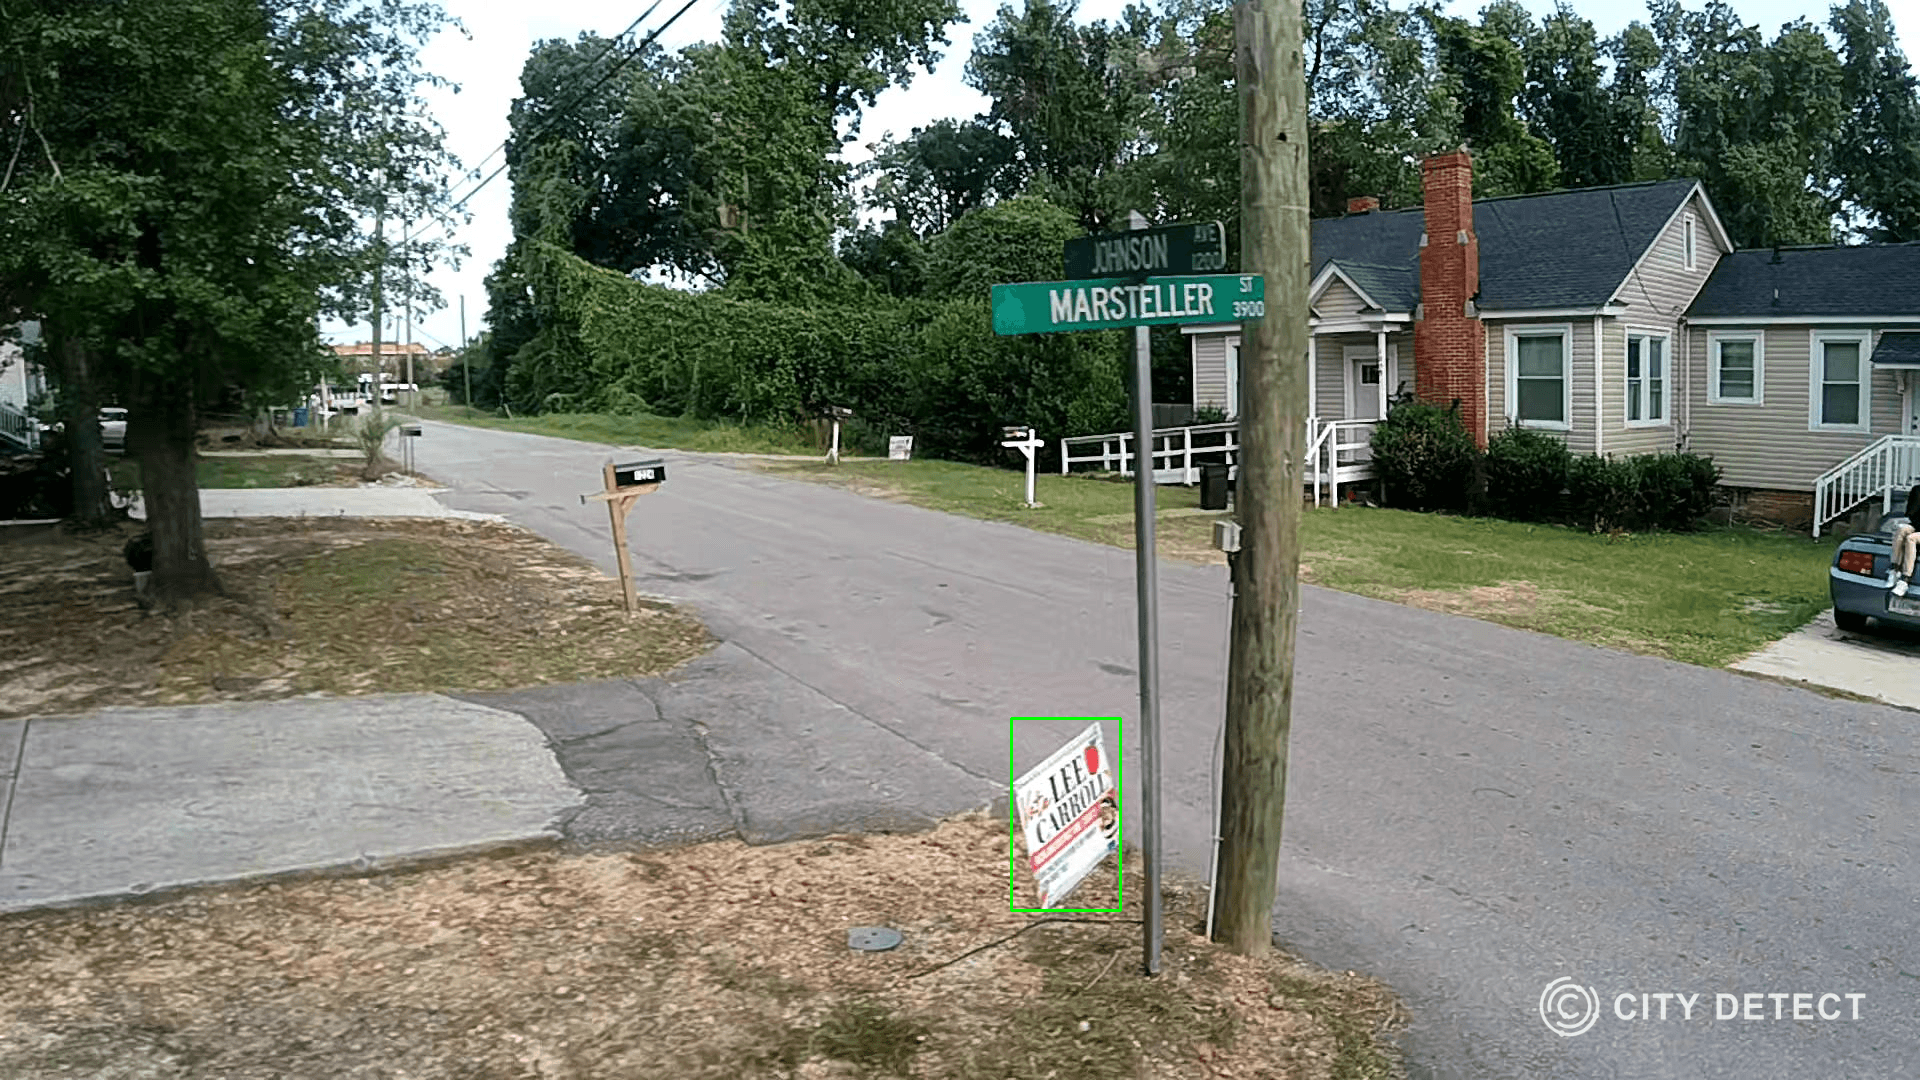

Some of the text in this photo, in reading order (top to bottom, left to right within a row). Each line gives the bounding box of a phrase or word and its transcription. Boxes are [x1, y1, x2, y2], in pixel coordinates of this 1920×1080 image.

[1091, 223, 1217, 273] JOHNSON AVE
[1192, 251, 1224, 270] 1200
[1049, 276, 1254, 324] MARSTELLER ST
[1232, 300, 1264, 318] 3900
[1048, 755, 1087, 802] LEE
[1036, 773, 1111, 844] CARROLL
